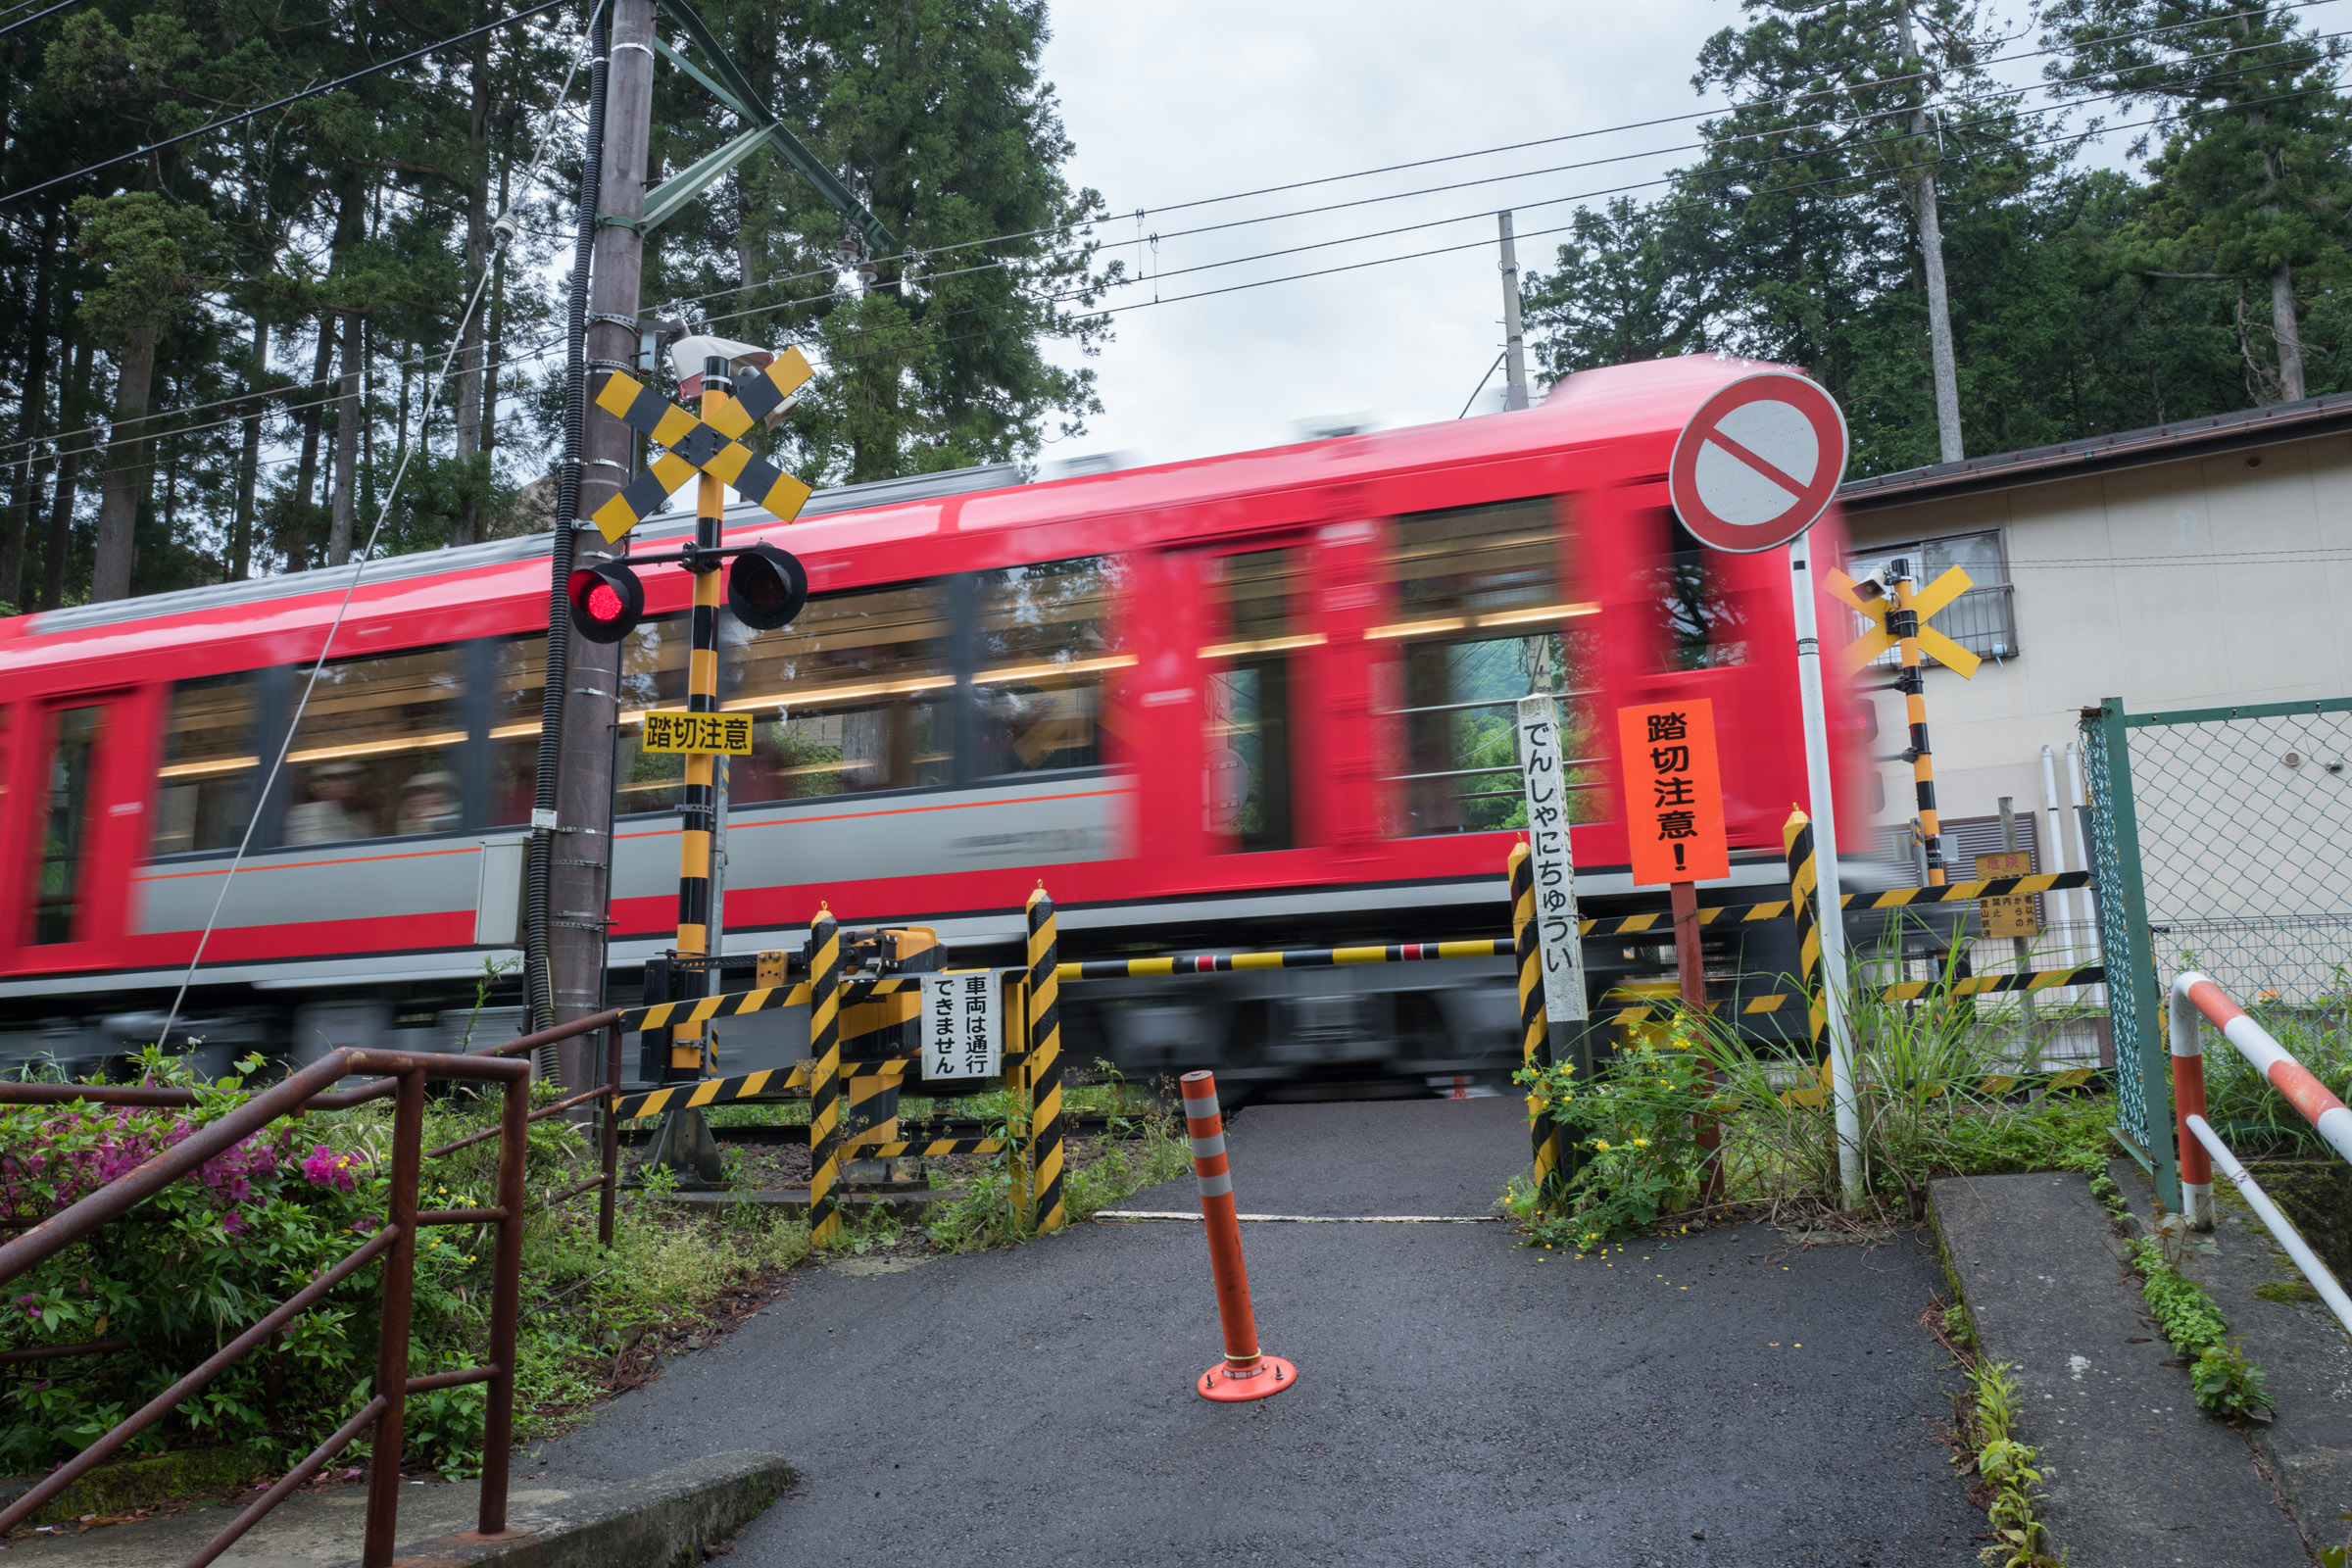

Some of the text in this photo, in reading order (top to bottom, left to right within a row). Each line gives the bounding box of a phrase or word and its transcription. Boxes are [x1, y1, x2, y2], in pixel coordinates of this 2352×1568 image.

[647, 716, 749, 750] 踏切注意
[1646, 711, 1698, 871] 踏切注意!
[1524, 722, 1572, 973] でんしゃにちゅうい
[1986, 855, 2019, 870] 危険
[934, 980, 956, 1074] できません
[965, 976, 988, 1074] 車両は通行
